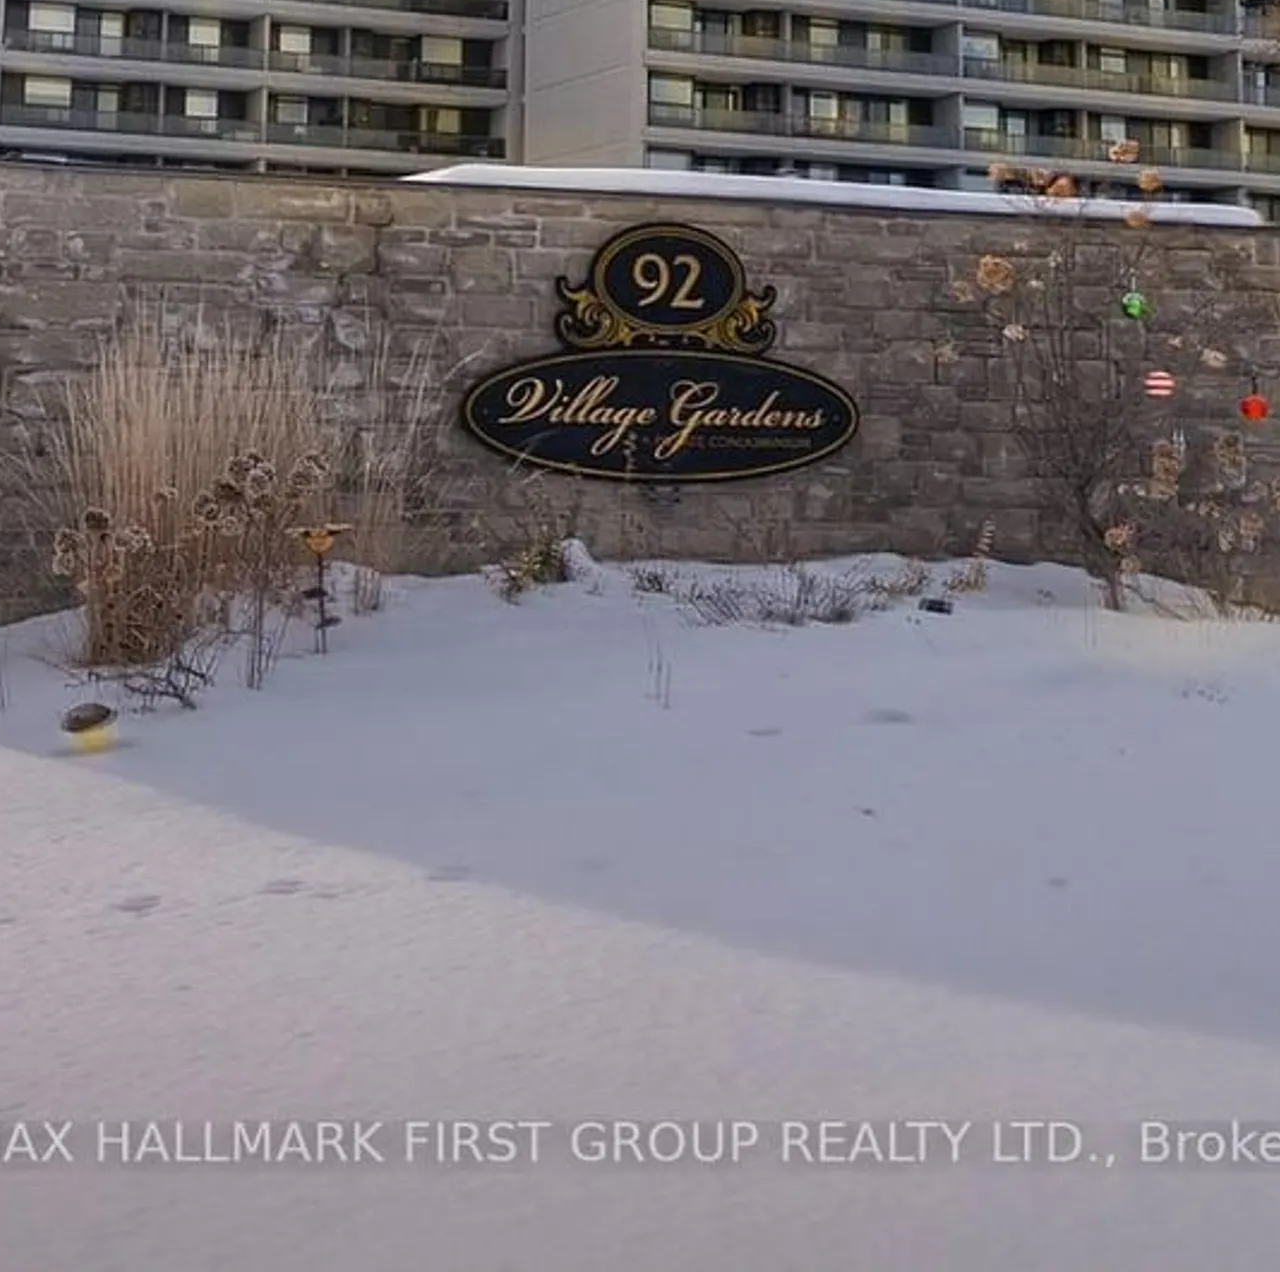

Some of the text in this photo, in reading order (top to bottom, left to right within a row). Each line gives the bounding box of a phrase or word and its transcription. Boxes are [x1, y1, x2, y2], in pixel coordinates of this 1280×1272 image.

[634, 254, 705, 307] 92
[498, 376, 825, 459] Village Gardens
